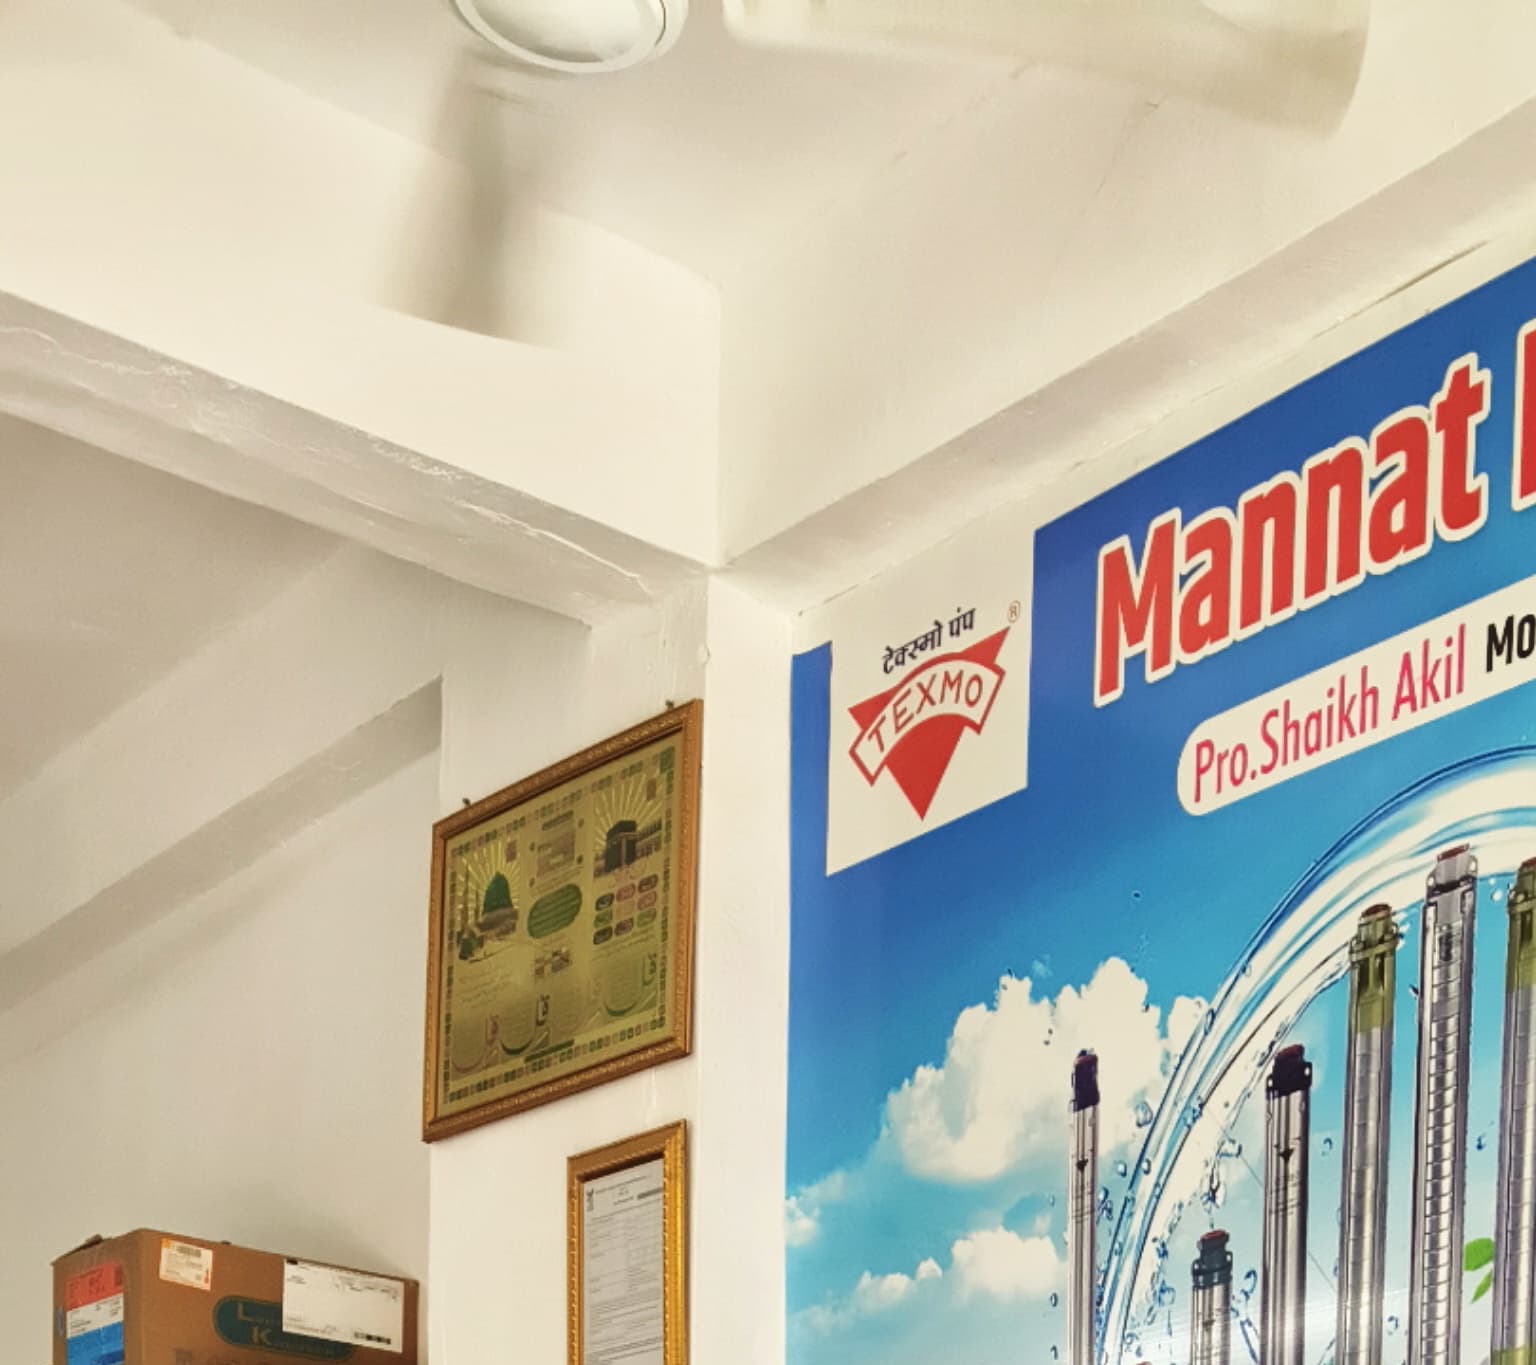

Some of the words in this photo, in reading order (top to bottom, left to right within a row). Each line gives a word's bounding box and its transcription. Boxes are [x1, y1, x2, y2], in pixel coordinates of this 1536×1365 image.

[1097, 362, 1480, 698] Mannat
[948, 606, 976, 639] पंप
[867, 669, 983, 753] TEXMO
[1194, 680, 1380, 804] Pro.Shaikh
[1392, 626, 1466, 722] Akil
